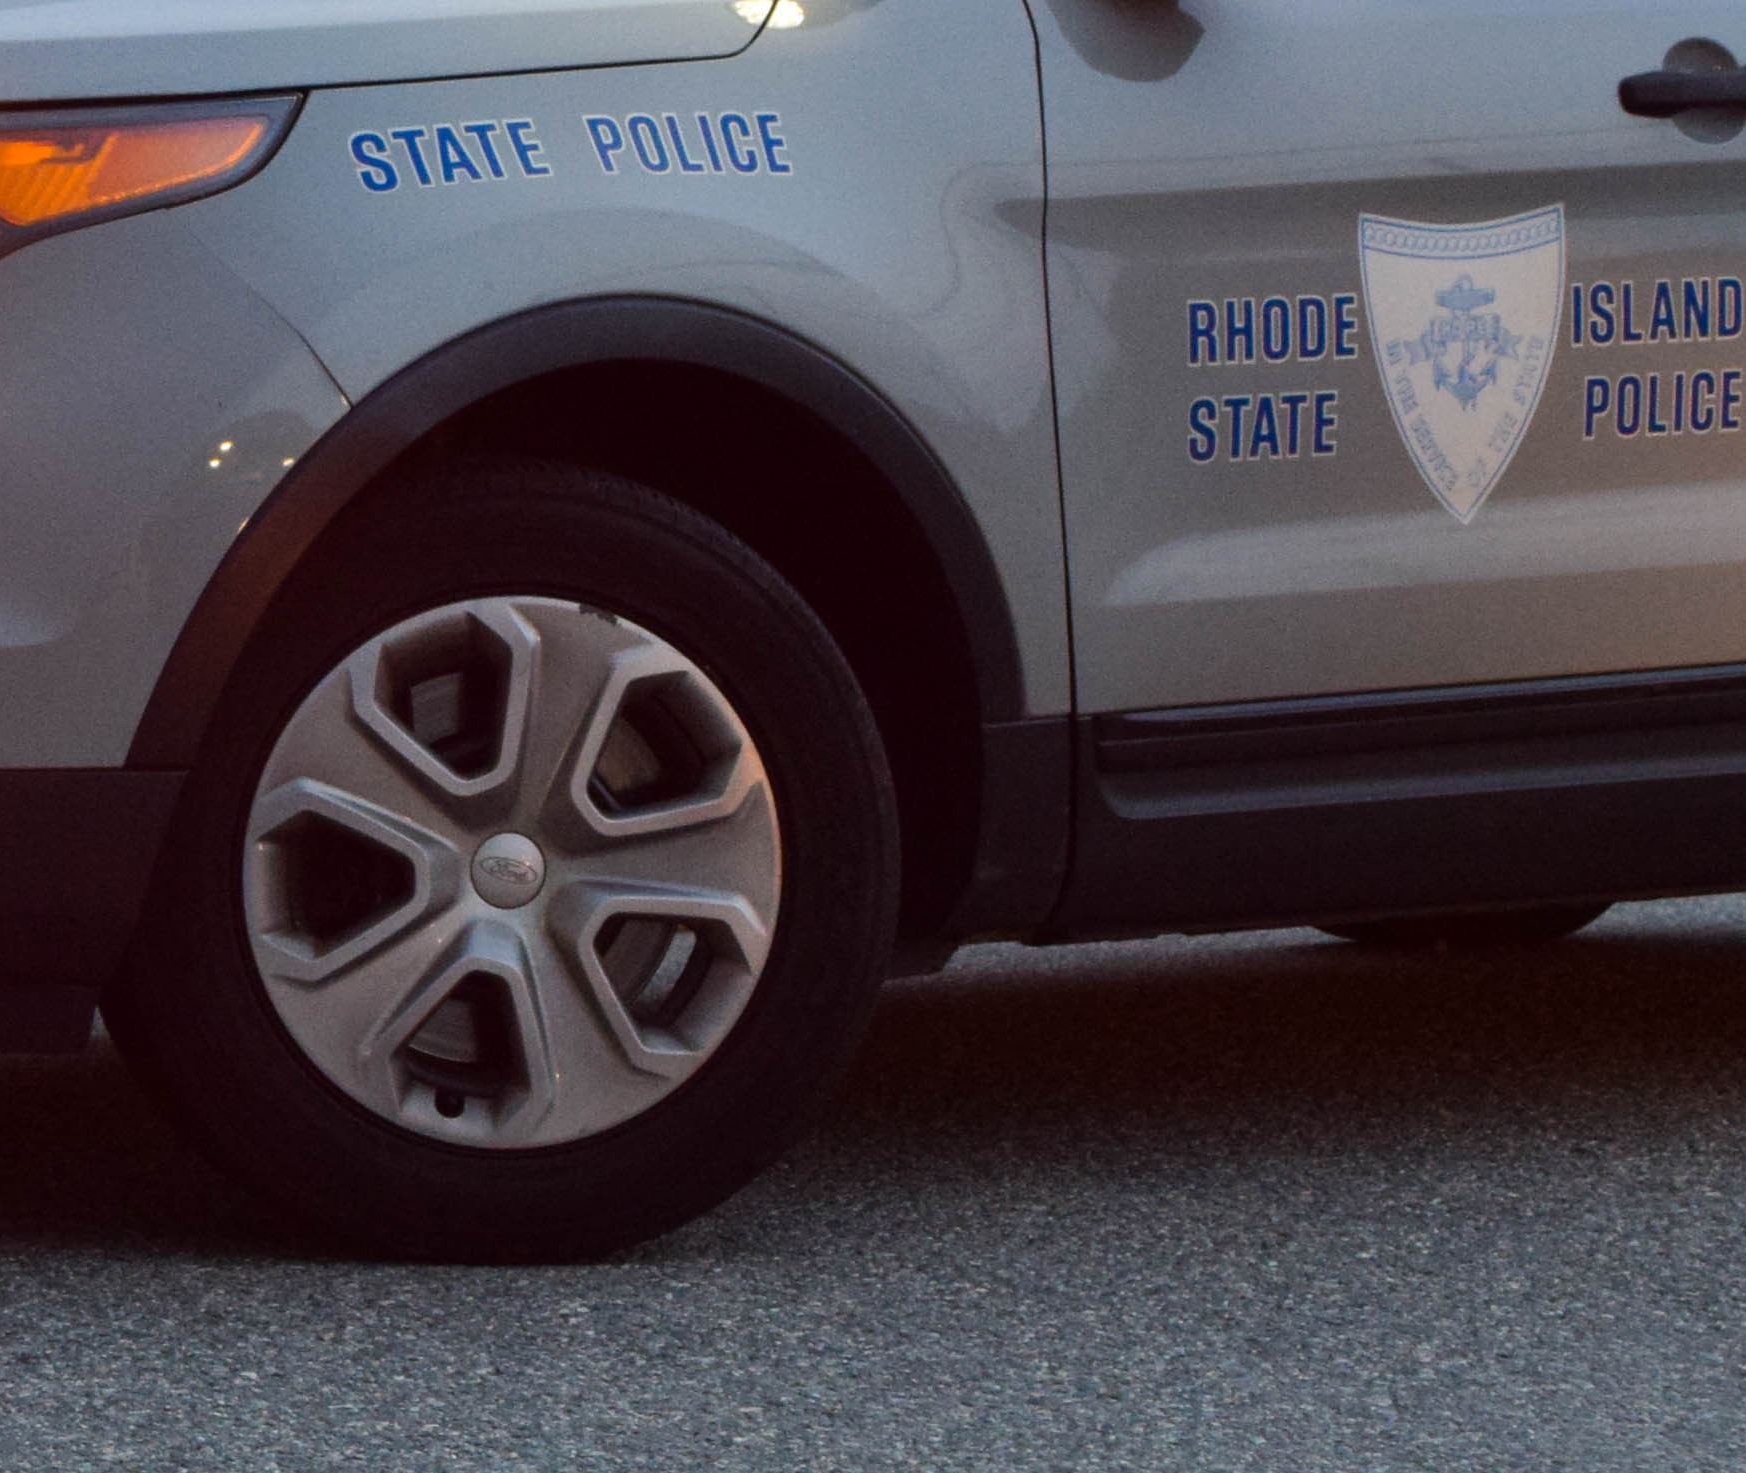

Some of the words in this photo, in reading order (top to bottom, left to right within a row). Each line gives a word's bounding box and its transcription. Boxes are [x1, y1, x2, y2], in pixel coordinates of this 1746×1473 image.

[350, 118, 552, 193] STATE
[583, 112, 792, 174] POLICE
[1187, 294, 1357, 366] RHODE
[1571, 276, 1743, 346] ISLAND
[1188, 390, 1338, 464] STATE
[1583, 370, 1742, 440] POLICE
